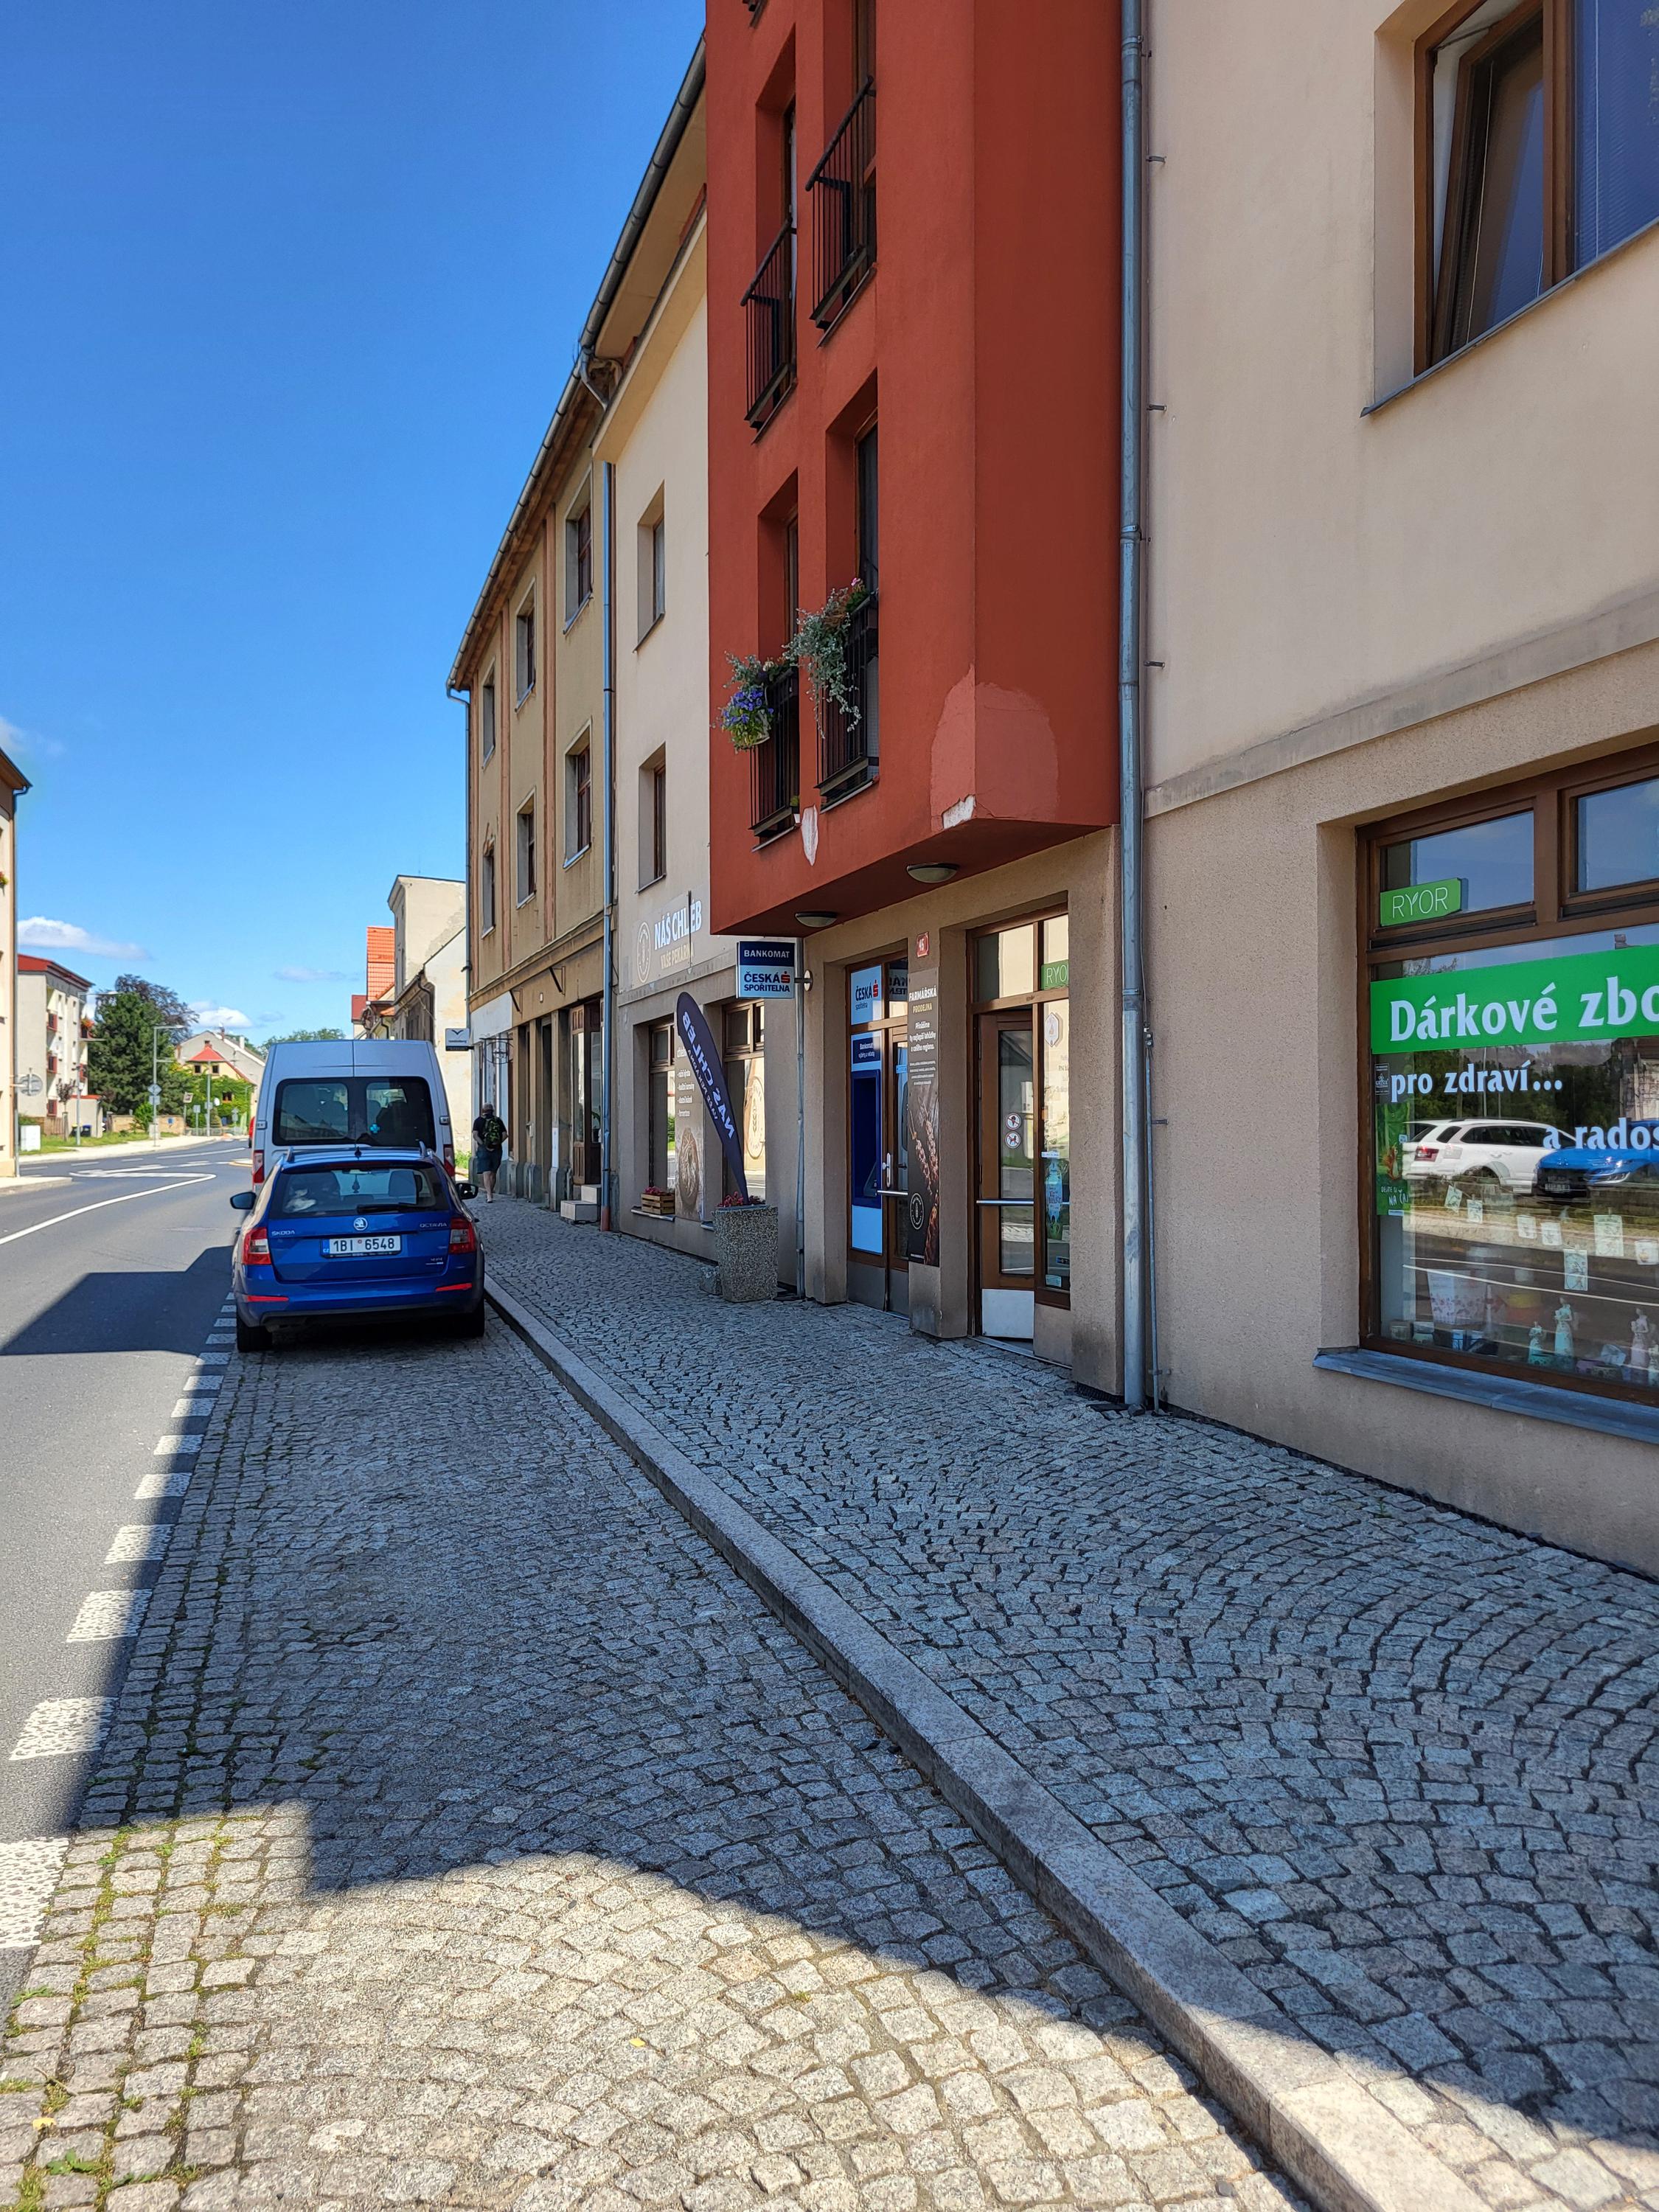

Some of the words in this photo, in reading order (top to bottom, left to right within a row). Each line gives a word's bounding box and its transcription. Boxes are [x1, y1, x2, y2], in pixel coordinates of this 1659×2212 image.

[1392, 886, 1449, 919] RYOR
[654, 912, 671, 950] NÁŠ
[672, 899, 702, 942] CHLÉB
[744, 950, 790, 958] BANKOMAT
[744, 971, 780, 984] ČESKÁ
[744, 984, 790, 992] SPOŘITELNA
[855, 982, 873, 1001] ČESKÁ
[908, 985, 937, 1002] FARMÁŘSKÁ
[912, 1003, 933, 1014] PRODEJNA
[1389, 981, 1558, 1042] Dárkové
[1391, 1071, 1433, 1103] pro
[1444, 1060, 1562, 1093] zdraví...
[1543, 1126, 1561, 1150] a
[1388, 1194, 1397, 1206] NA
[333, 1239, 353, 1252] 1BI
[365, 1237, 394, 1251] 6548
